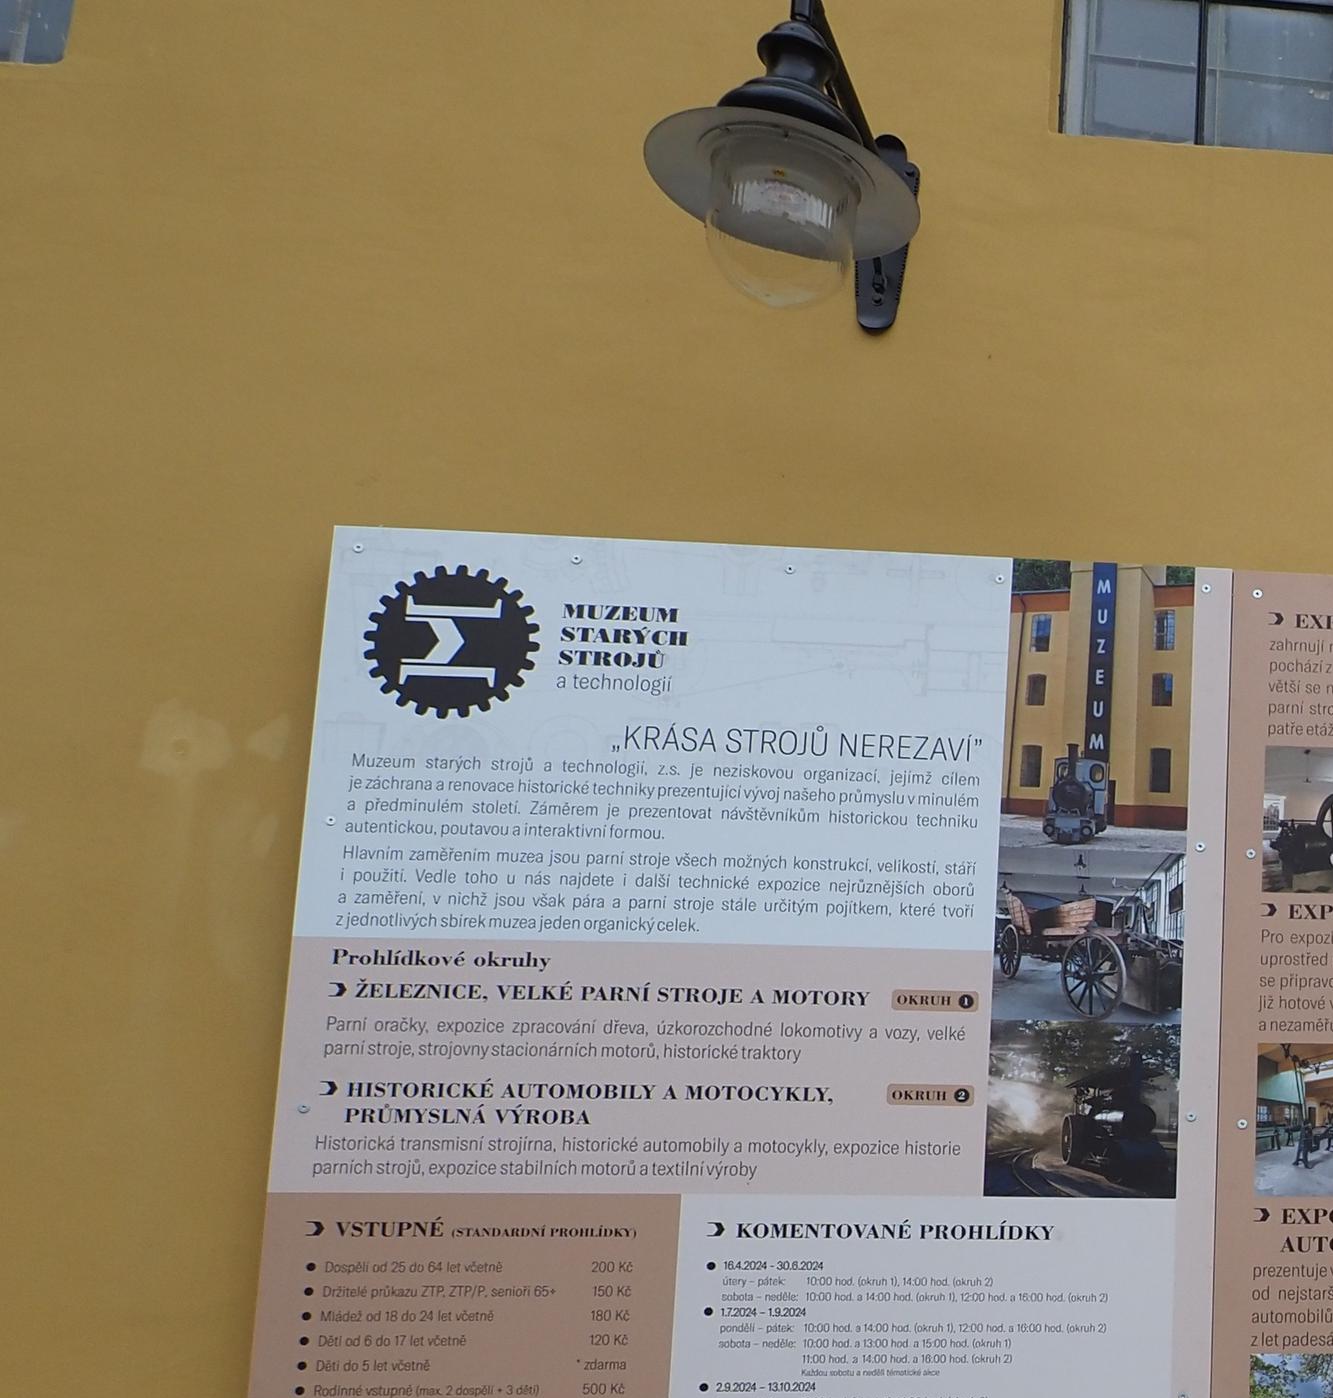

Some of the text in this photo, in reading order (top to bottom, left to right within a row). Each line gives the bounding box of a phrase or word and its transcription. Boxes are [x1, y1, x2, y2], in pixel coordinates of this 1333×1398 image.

[563, 604, 678, 622] MUZEUM
[560, 626, 687, 645] STARÝCH
[558, 649, 664, 668] STROJŮ
[1088, 580, 1111, 750] MUZEUM
[556, 673, 672, 696] a technologií
[726, 728, 827, 756] STROJŮ
[352, 753, 415, 768] Muzeum
[425, 755, 480, 773] starých
[491, 757, 533, 774] strojů
[544, 761, 552, 772] a
[657, 765, 680, 775] z.s.
[689, 763, 703, 779] je
[713, 764, 793, 780] neziskovou
[889, 769, 932, 787] jejímž
[941, 771, 979, 786] cílem
[333, 949, 550, 972] Prohlídkové okruhy
[355, 979, 869, 1005] ŽELEZNICE, VELKÉ PARNÍ STROJE A MOTORY
[897, 994, 950, 1005] OKRUH
[347, 1082, 832, 1102] HISTORICKÉ AUTOMOBILY A MOTOCYKLY,
[892, 1090, 946, 1100] OKRUH
[345, 1103, 589, 1124] PRŮMYSLNÁ VÝROBA
[336, 1216, 443, 1237] VSTUPNÉ
[451, 1228, 636, 1238] (STANDARDNÍ PROHLÍDKY)
[737, 1219, 1054, 1240] KOMENTOVANÉ PROHLÍDKY
[372, 1261, 388, 1272] od
[391, 1261, 406, 1273] 25
[409, 1261, 424, 1273] do
[427, 1261, 442, 1272] 64
[447, 1261, 460, 1272] let
[464, 1261, 502, 1272] včetně
[591, 1261, 632, 1273] 200 Kč
